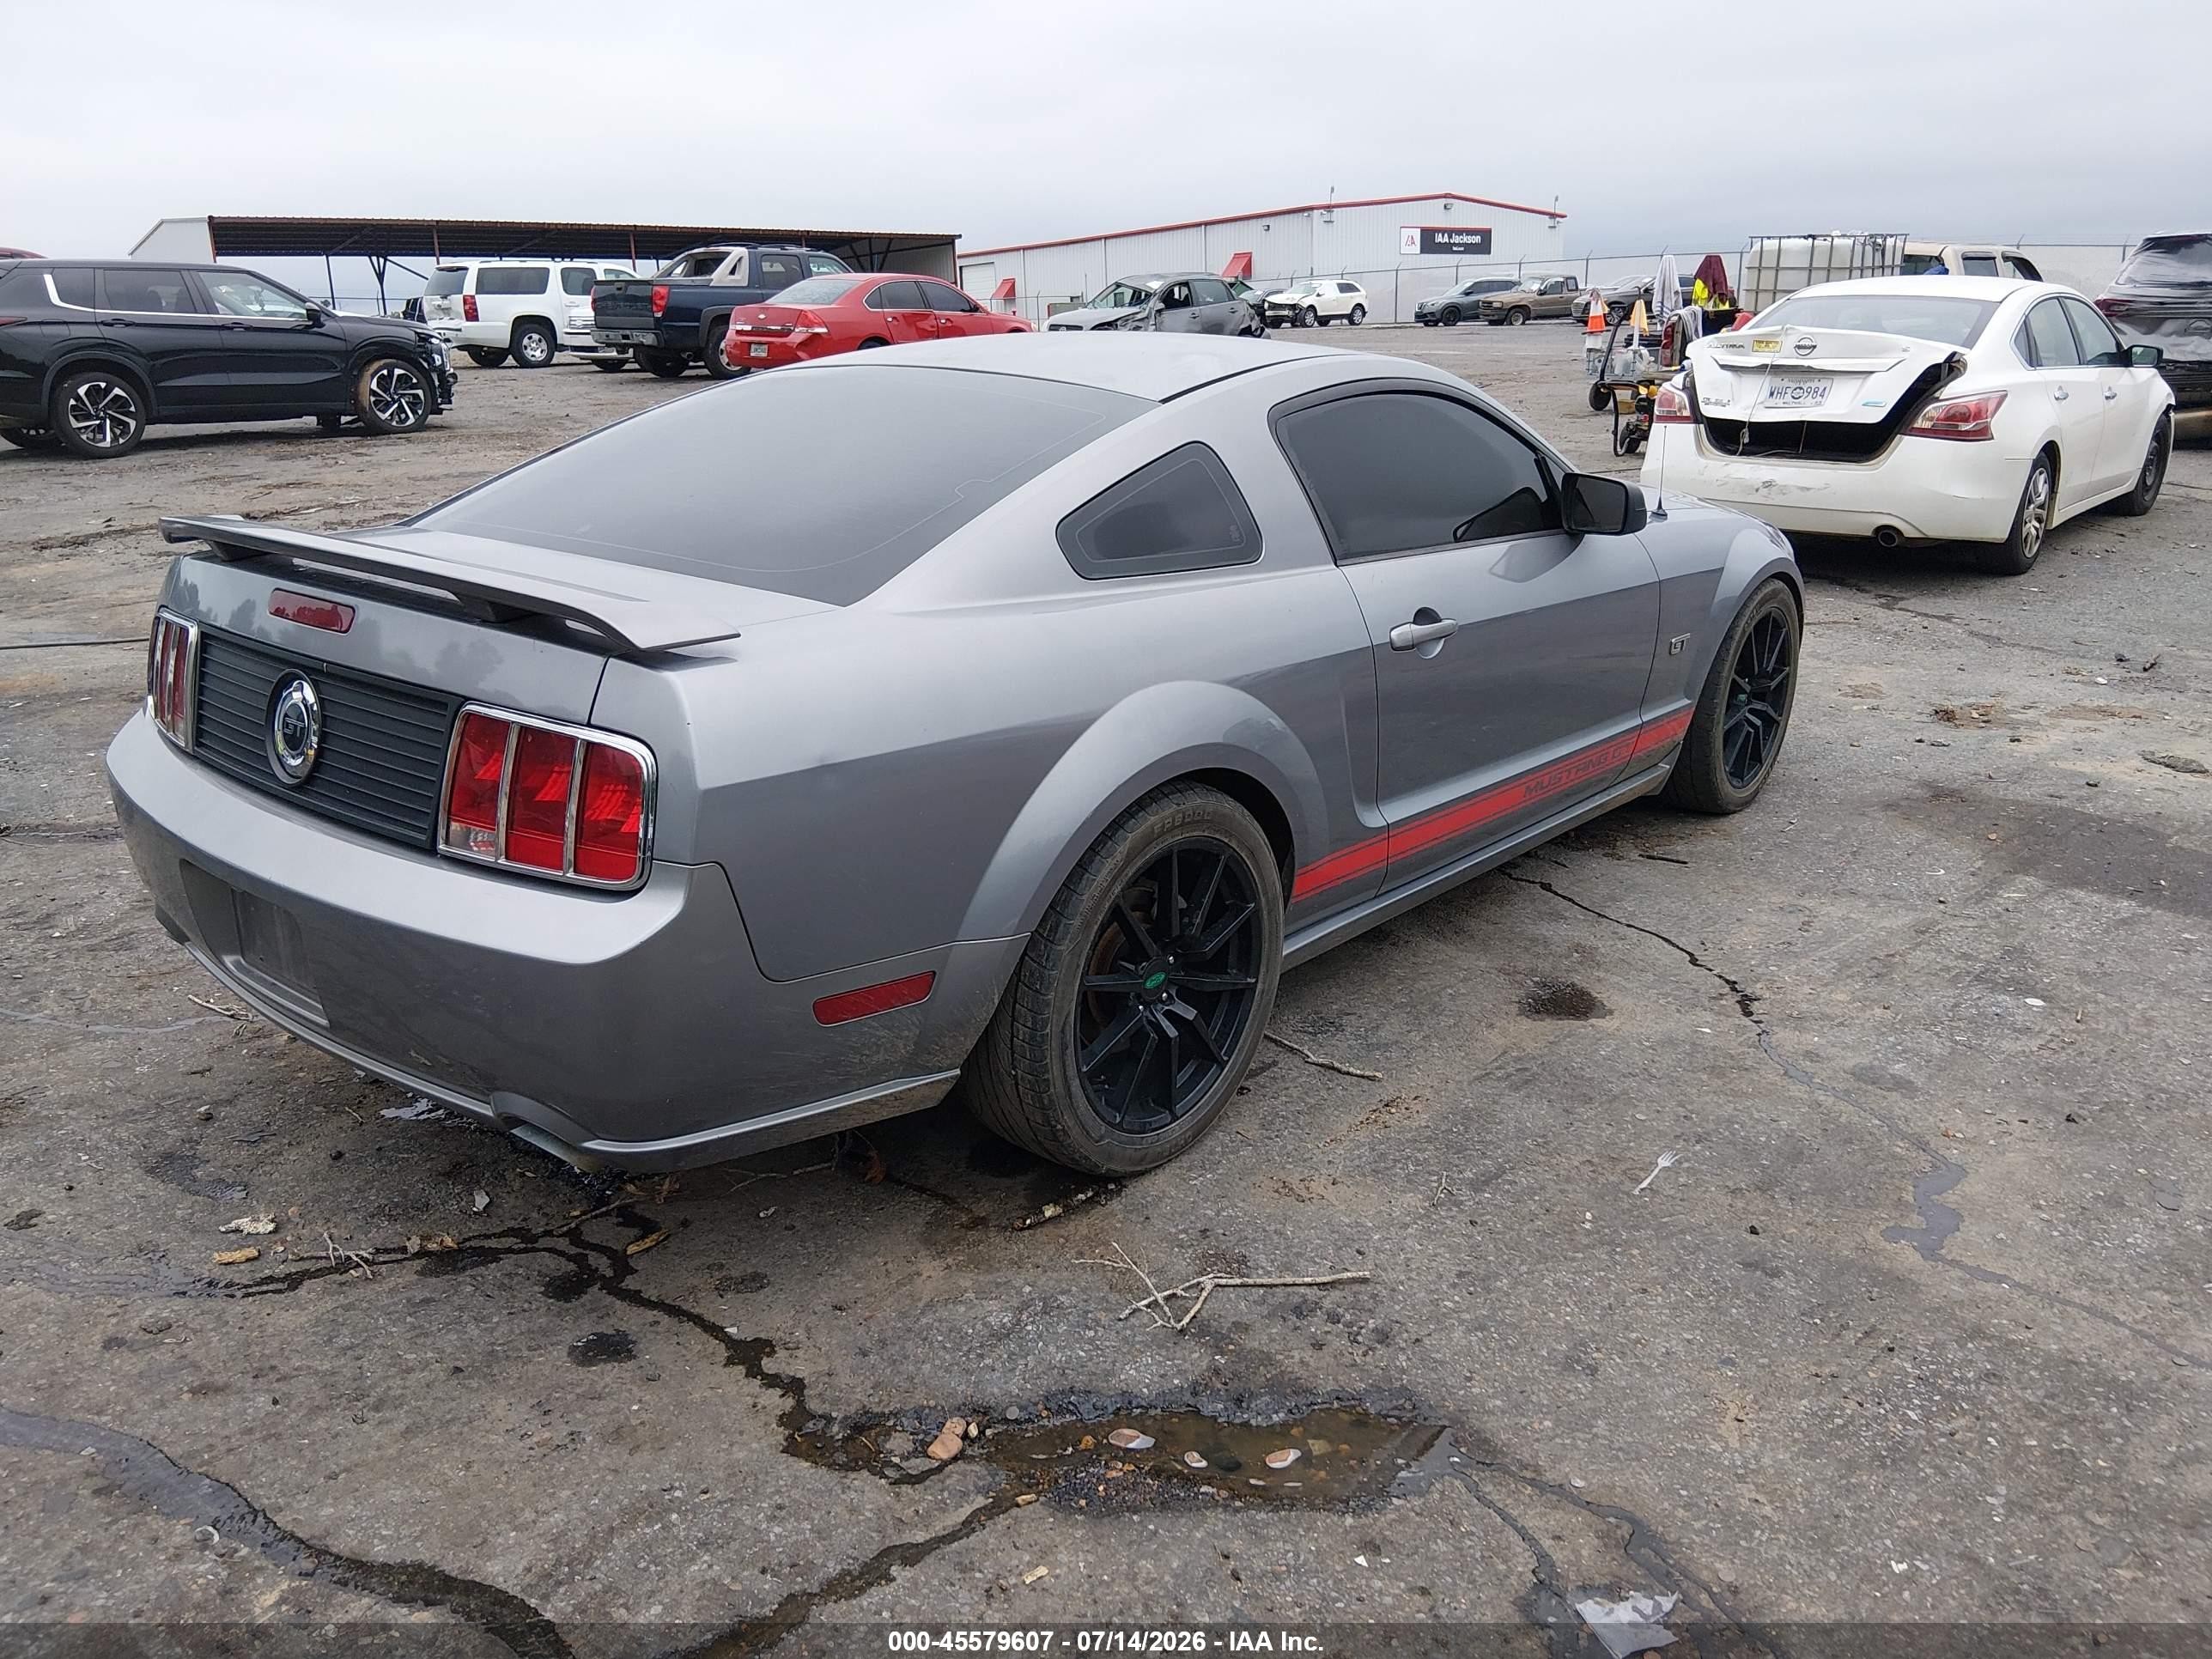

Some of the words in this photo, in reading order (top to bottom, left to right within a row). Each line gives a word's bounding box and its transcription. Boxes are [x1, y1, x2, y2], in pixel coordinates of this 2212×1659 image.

[1435, 233, 1449, 243] IAA
[1450, 233, 1481, 243] Jackson
[1768, 386, 1792, 399] WHF
[1802, 386, 1827, 399] 984
[1669, 633, 1690, 654] GT
[283, 716, 305, 737] GT
